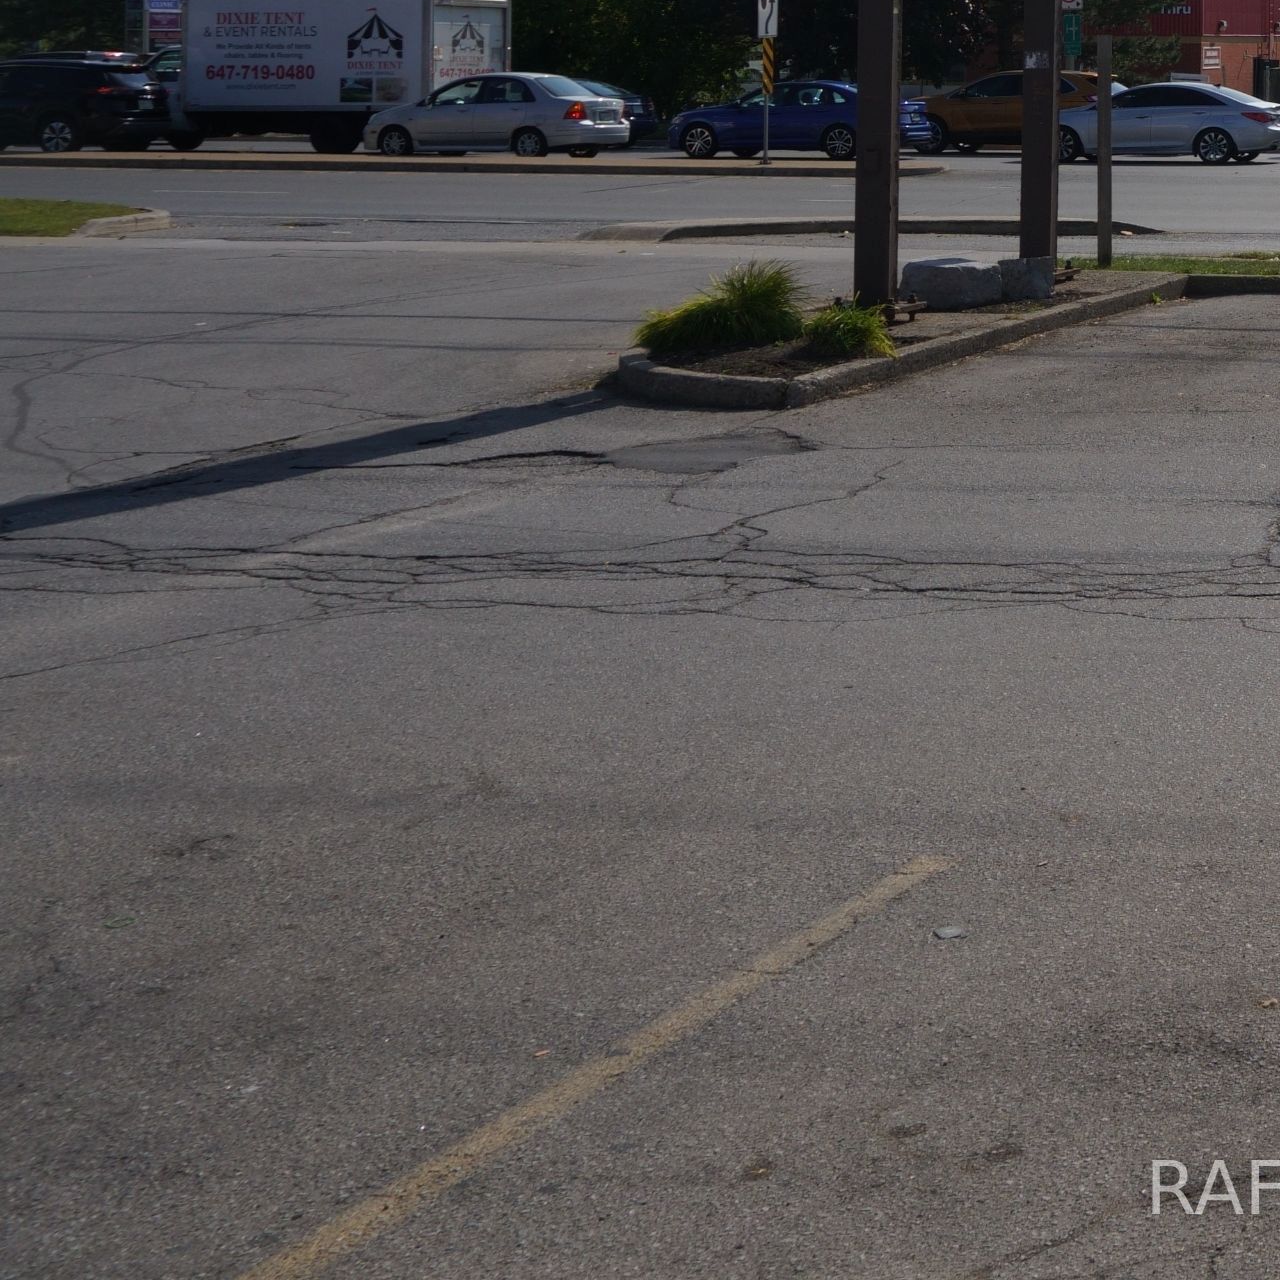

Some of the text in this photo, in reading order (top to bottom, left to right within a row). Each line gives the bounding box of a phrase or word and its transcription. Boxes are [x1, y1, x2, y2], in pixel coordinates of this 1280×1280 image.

[216, 12, 305, 25] DIXIE TENT
[203, 26, 318, 37] & EVENT RENTALS
[347, 61, 403, 70] DIXIE TENT
[206, 65, 316, 80] 647-719-0480
